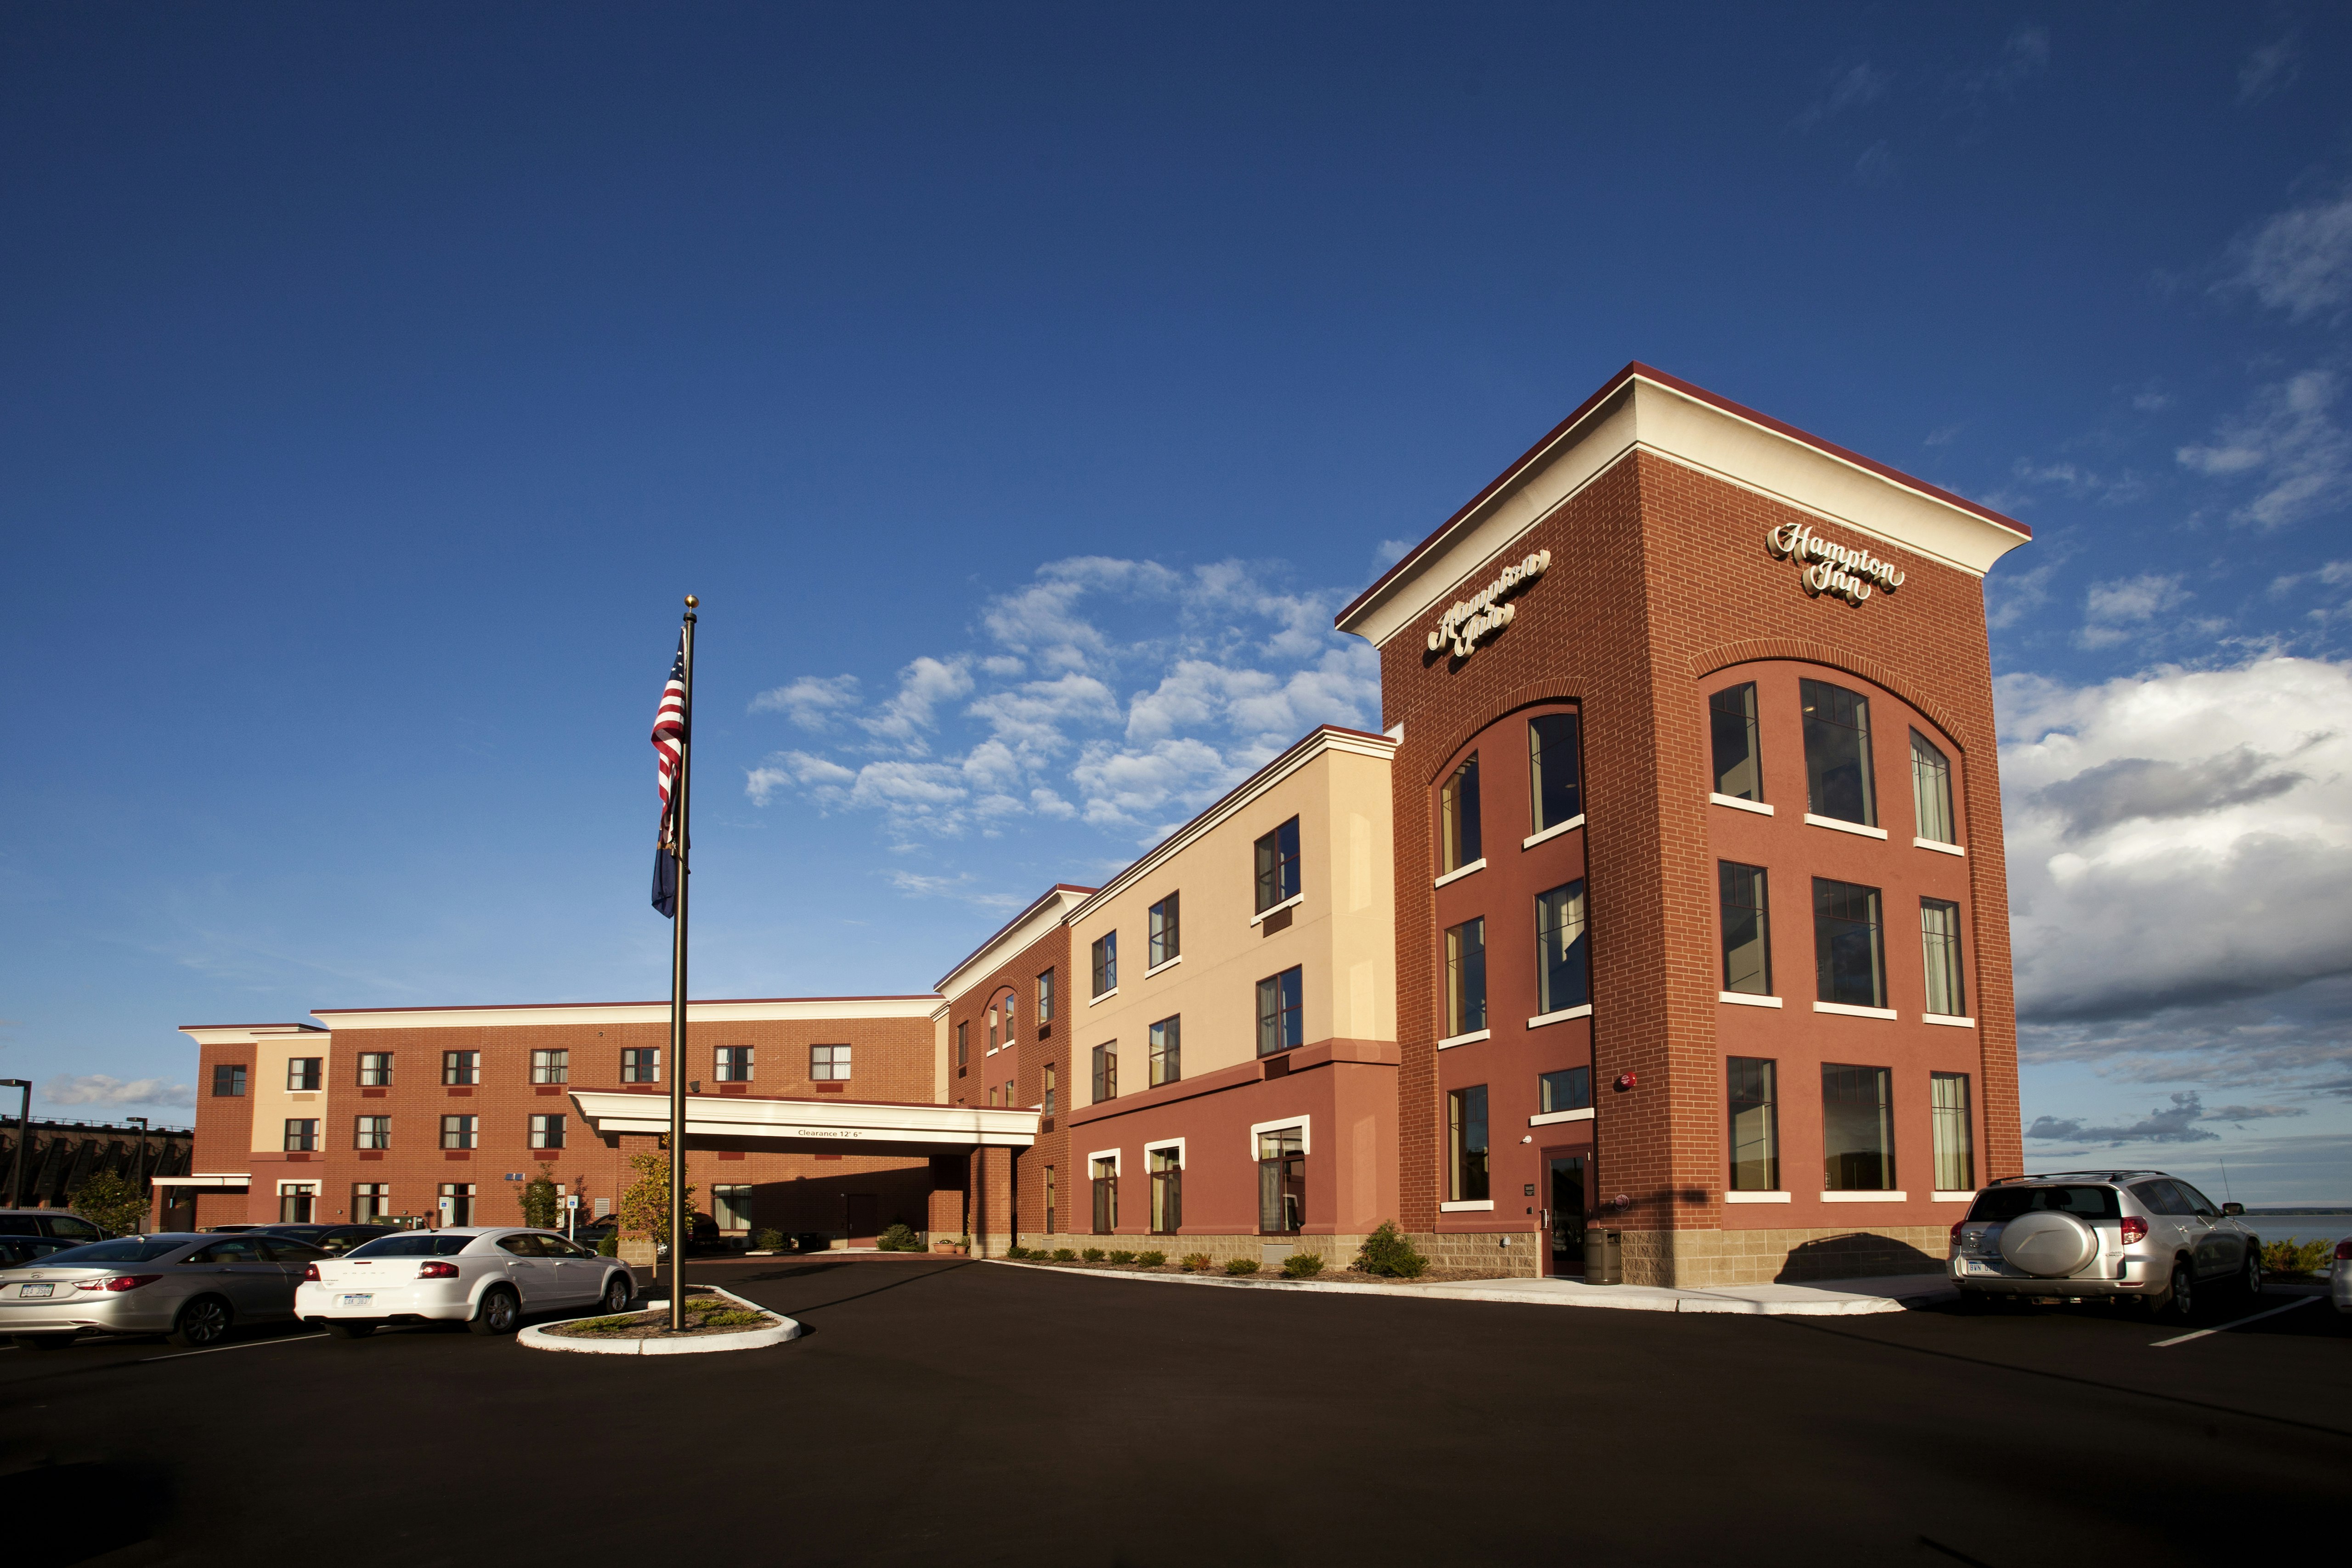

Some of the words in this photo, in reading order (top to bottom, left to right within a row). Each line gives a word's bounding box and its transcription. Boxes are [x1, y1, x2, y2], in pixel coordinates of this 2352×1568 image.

[1773, 522, 1905, 587] Hampton
[1809, 561, 1871, 600] Inn
[1427, 549, 1551, 652] Hampton
[1454, 603, 1515, 657] Inn
